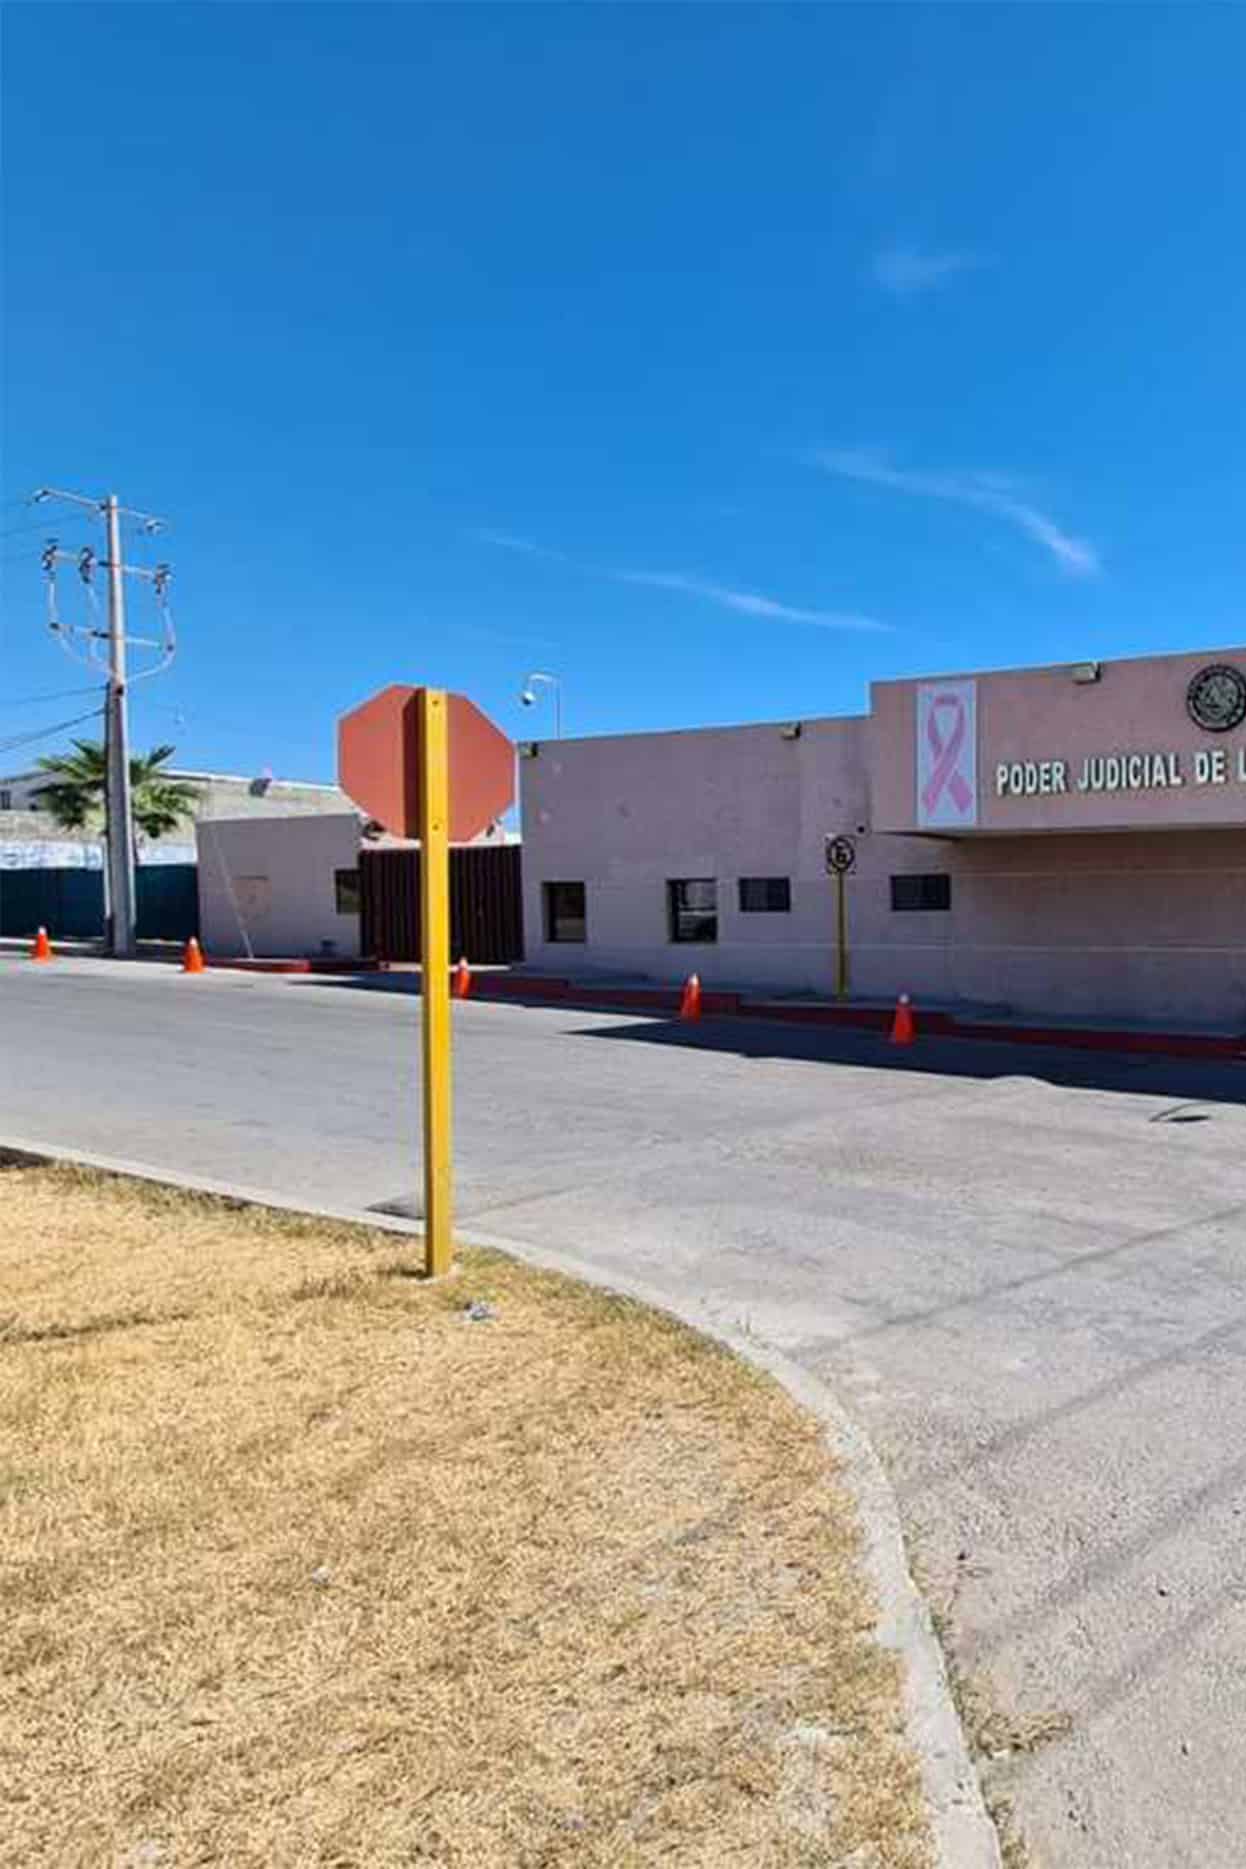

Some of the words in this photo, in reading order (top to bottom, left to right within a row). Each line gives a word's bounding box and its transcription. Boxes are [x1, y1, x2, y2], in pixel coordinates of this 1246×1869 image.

[996, 760, 1067, 796] PODER
[1077, 752, 1184, 790] JUDICIAL
[1195, 750, 1226, 784] DE
